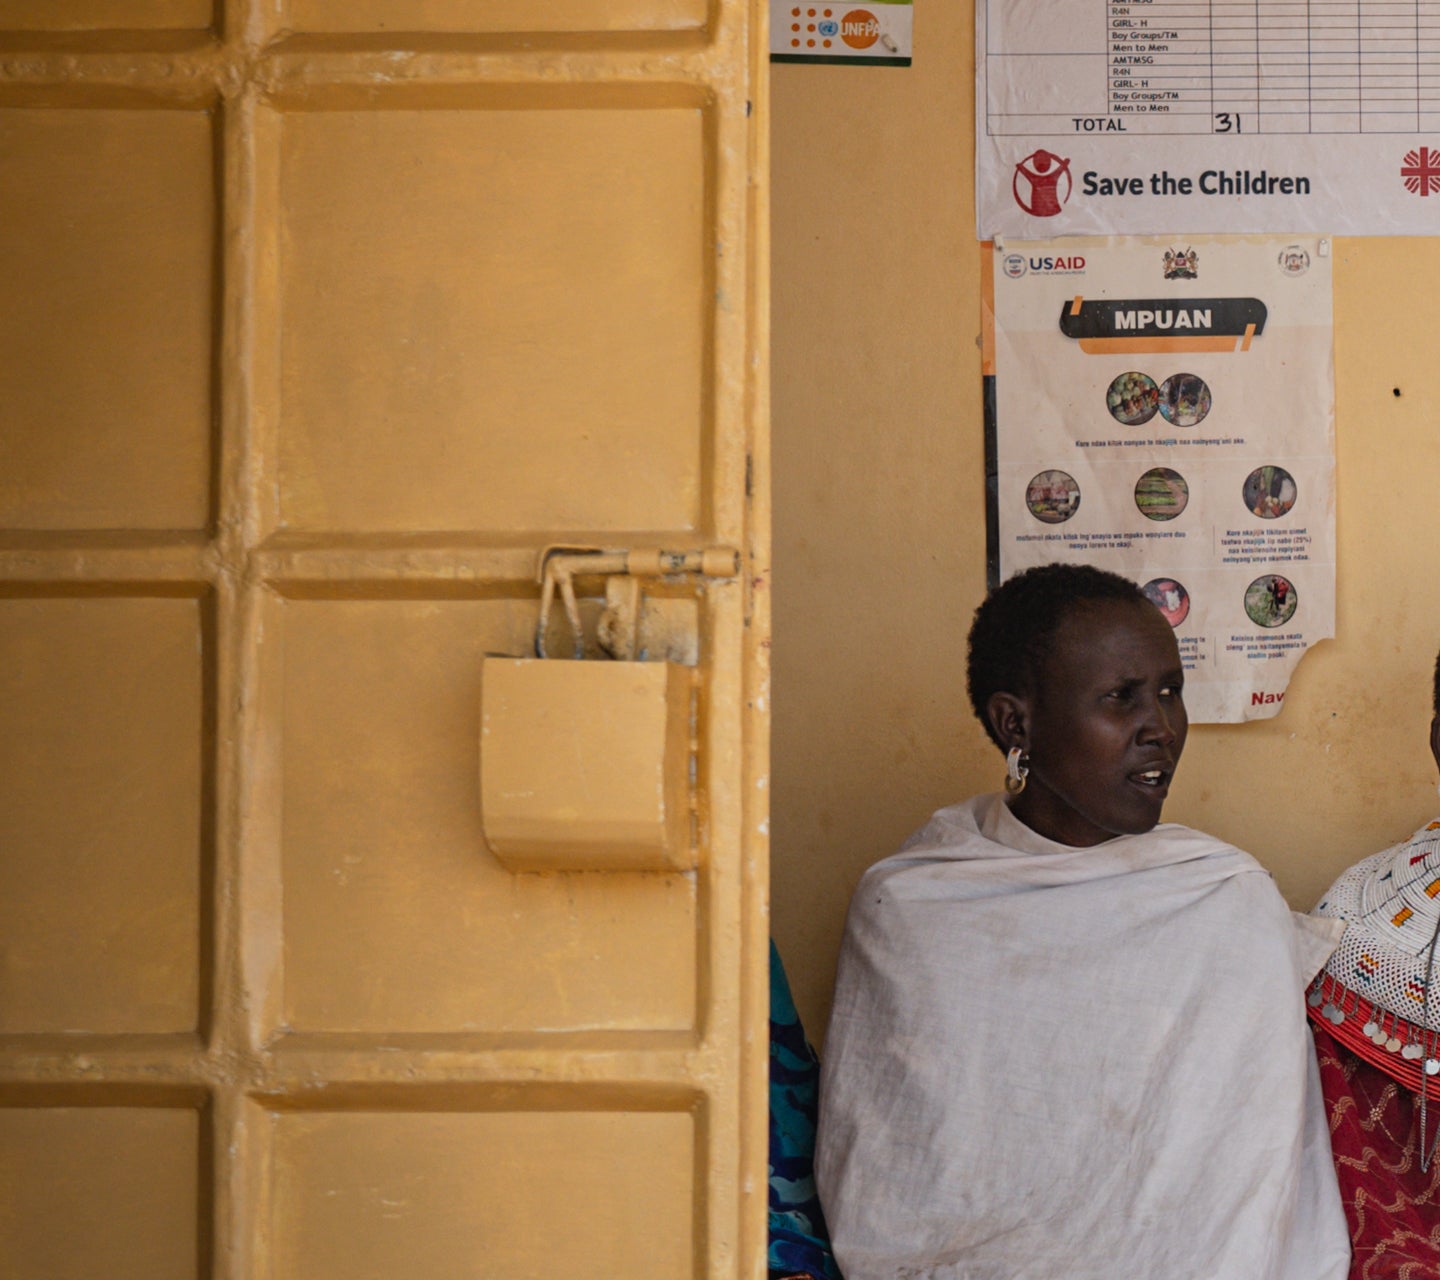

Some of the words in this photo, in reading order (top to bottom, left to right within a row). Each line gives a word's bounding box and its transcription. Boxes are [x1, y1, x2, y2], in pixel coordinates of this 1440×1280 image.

[1072, 118, 1127, 131] TOTAL
[1215, 113, 1241, 133] 31
[1083, 172, 1143, 196] Save
[1147, 170, 1192, 196] the
[1199, 169, 1311, 196] Children
[1029, 256, 1085, 270] USAID
[1114, 309, 1212, 330] MPUAN
